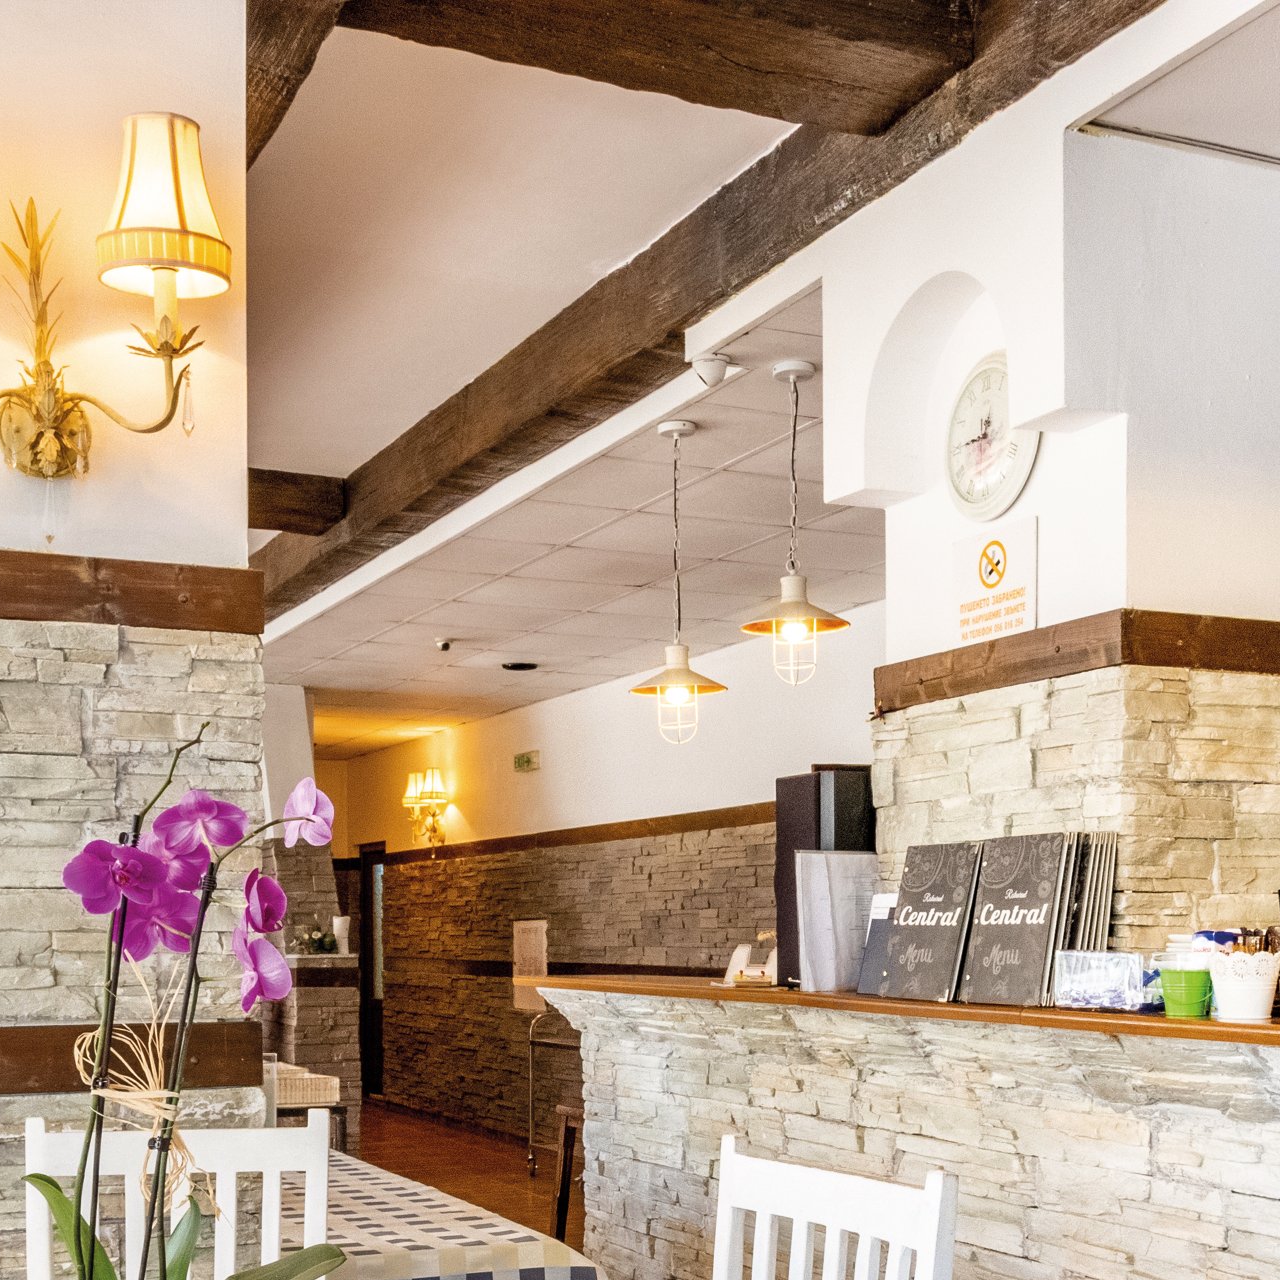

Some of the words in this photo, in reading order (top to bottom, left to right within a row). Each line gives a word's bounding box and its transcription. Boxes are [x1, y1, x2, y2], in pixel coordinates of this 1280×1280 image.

[899, 905, 962, 926] Central
[980, 903, 1049, 926] Central
[899, 943, 934, 972] Menu
[983, 943, 1021, 975] Menu
